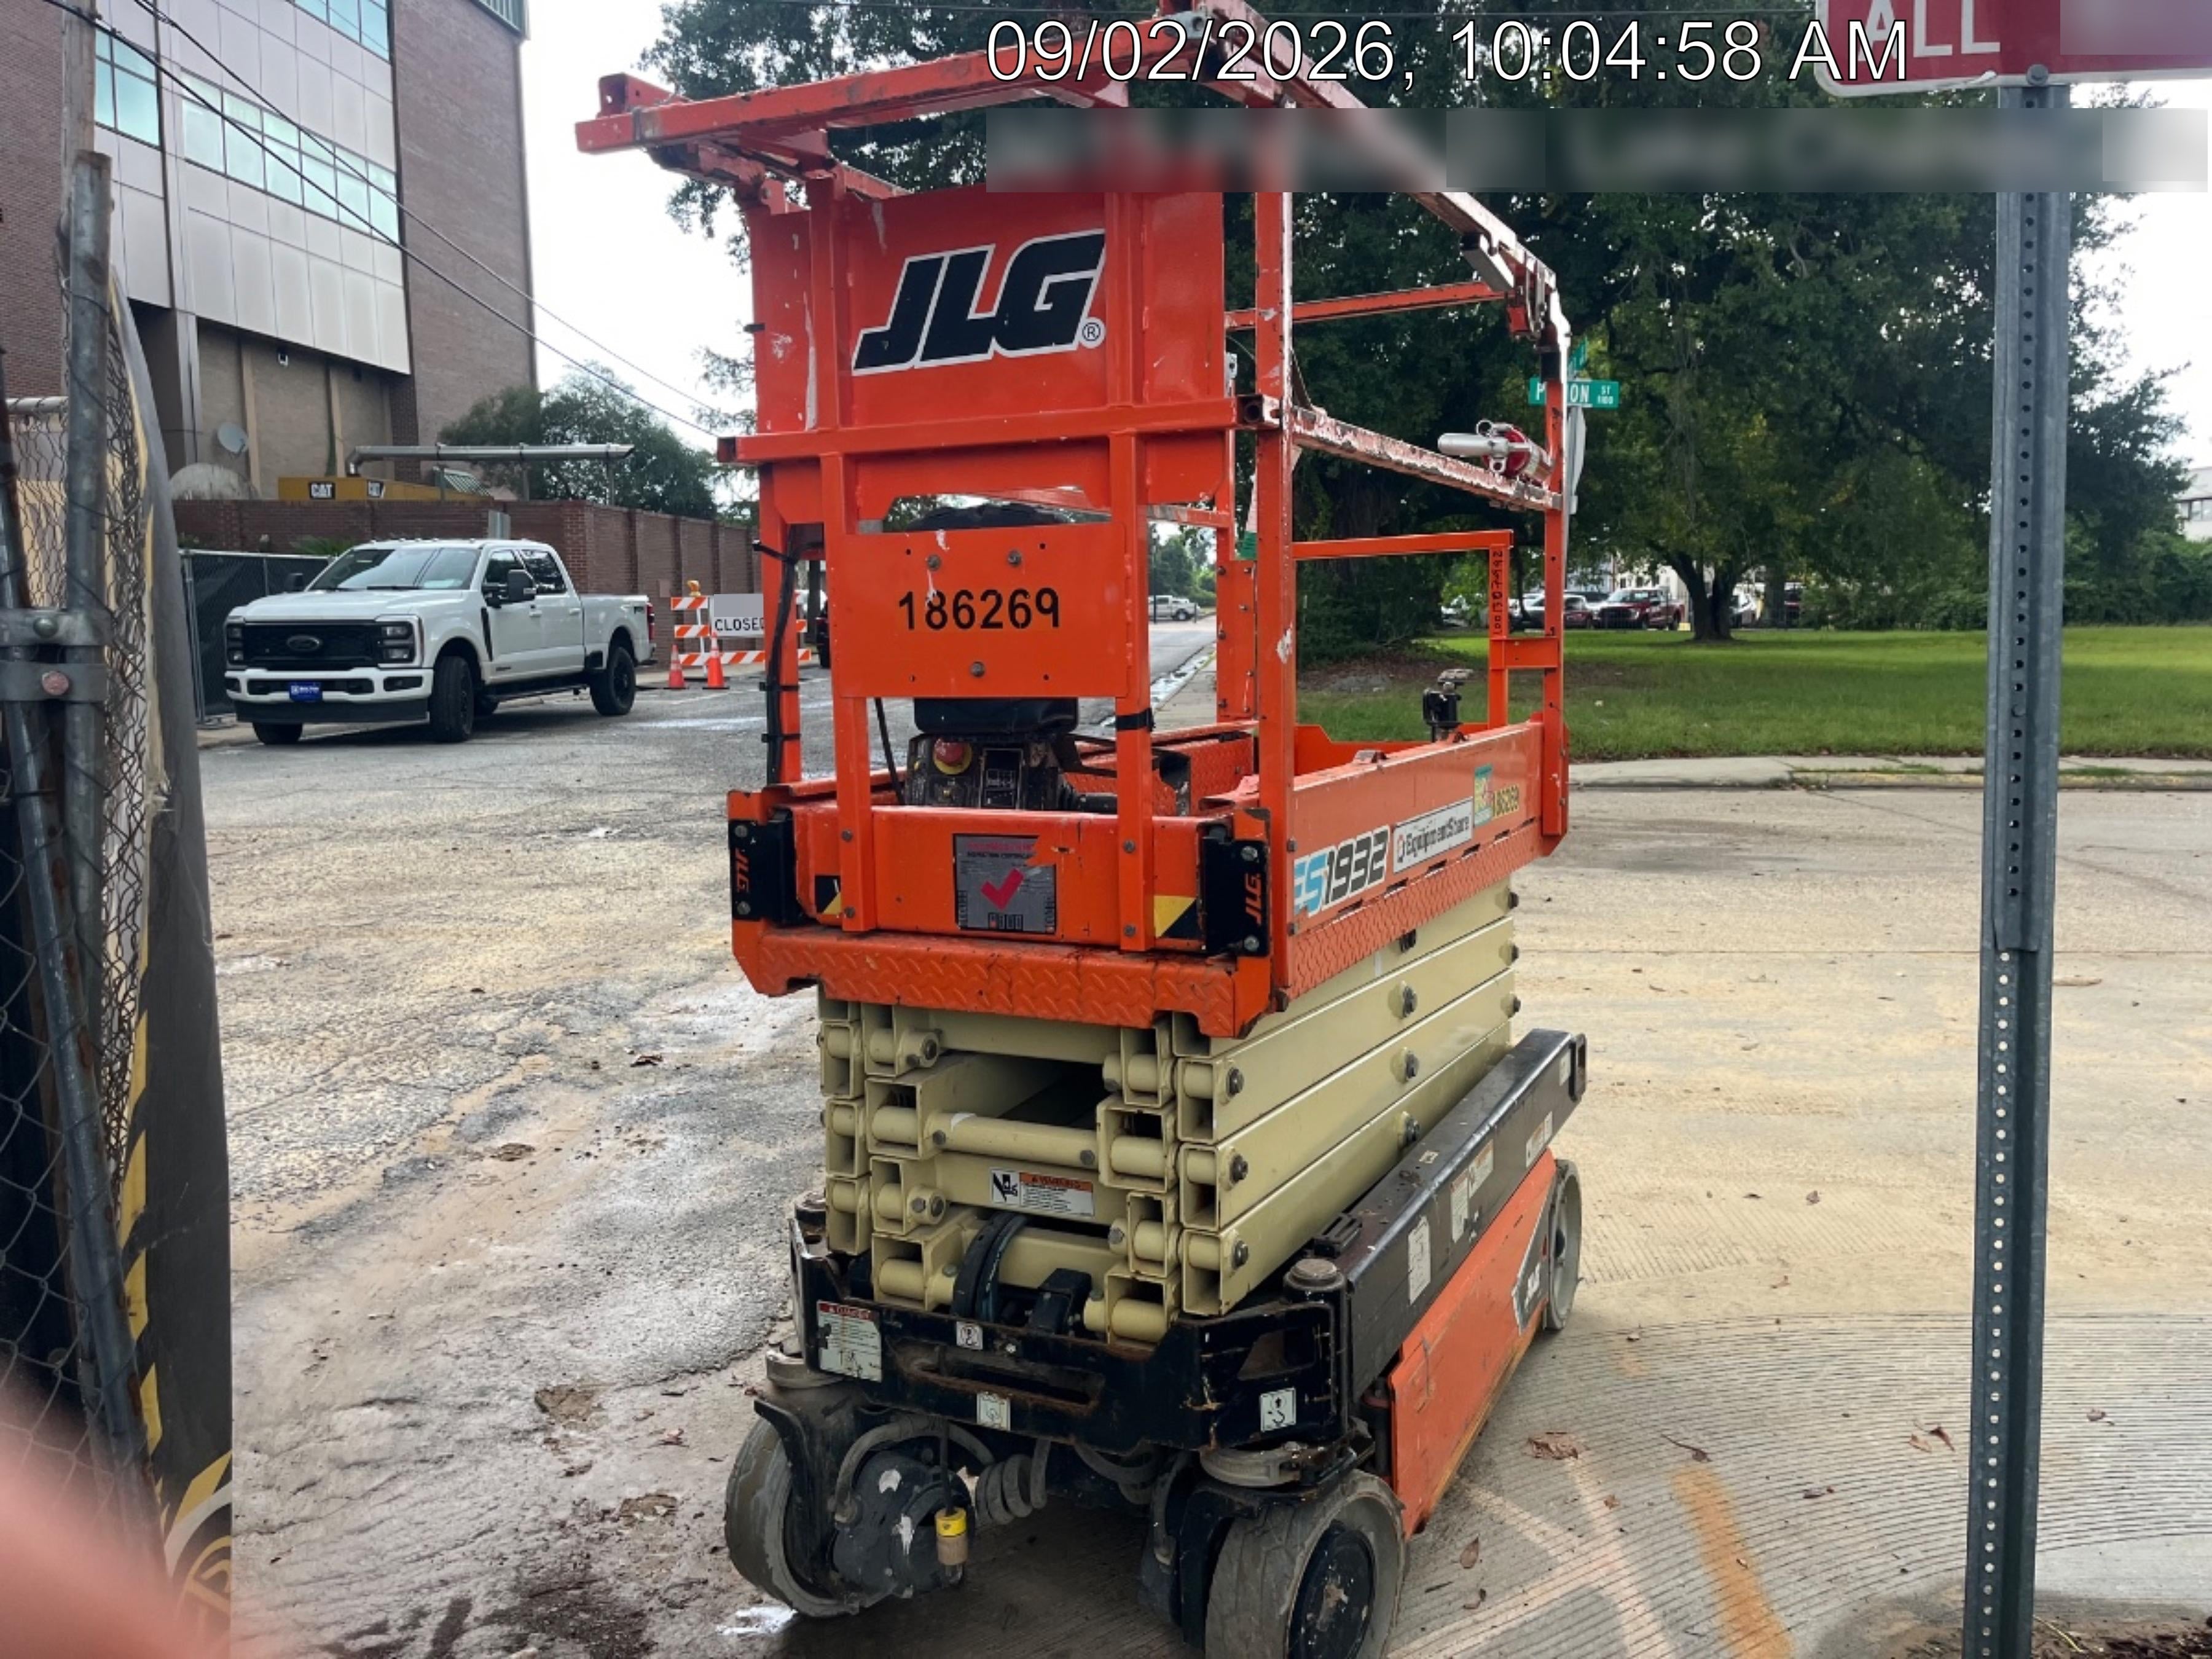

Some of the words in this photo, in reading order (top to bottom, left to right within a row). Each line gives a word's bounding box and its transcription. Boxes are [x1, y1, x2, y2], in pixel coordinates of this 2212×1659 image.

[852, 228, 1105, 375] JLG
[310, 484, 332, 498] CAT
[899, 587, 1059, 630] 186269
[1245, 873, 1261, 927] JLG
